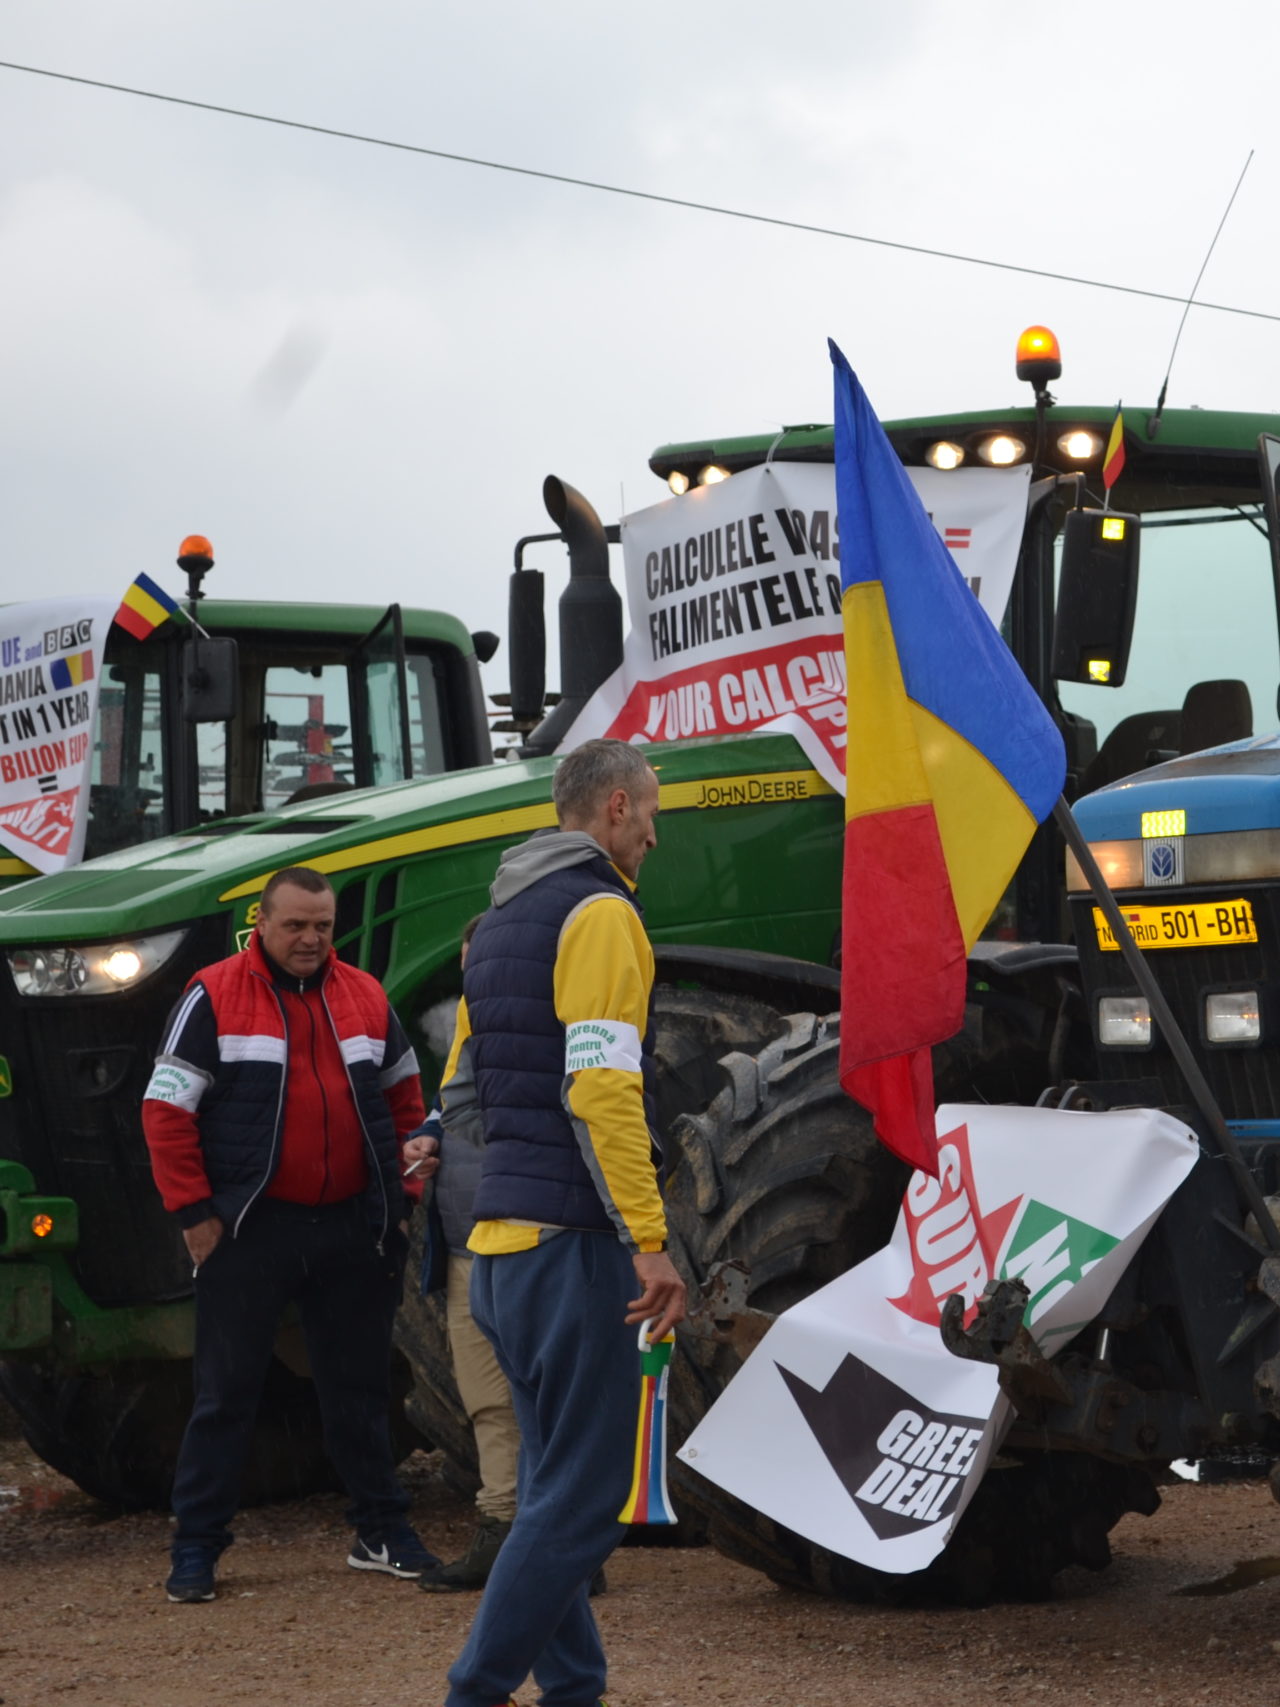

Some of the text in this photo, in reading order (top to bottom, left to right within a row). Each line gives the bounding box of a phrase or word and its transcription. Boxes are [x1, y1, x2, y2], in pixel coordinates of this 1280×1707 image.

[645, 513, 776, 601] CALCULELE
[44, 618, 94, 656] BBC
[648, 567, 824, 662] FALIMENTELE
[12, 707, 37, 741] IN
[36, 703, 52, 733] 1
[50, 691, 89, 730] YEAR
[643, 680, 717, 741] YOUR
[0, 740, 67, 784] BILION
[697, 780, 808, 805] JOHN DEERE
[1161, 910, 1200, 939] 501
[854, 1458, 960, 1521] DEAL
